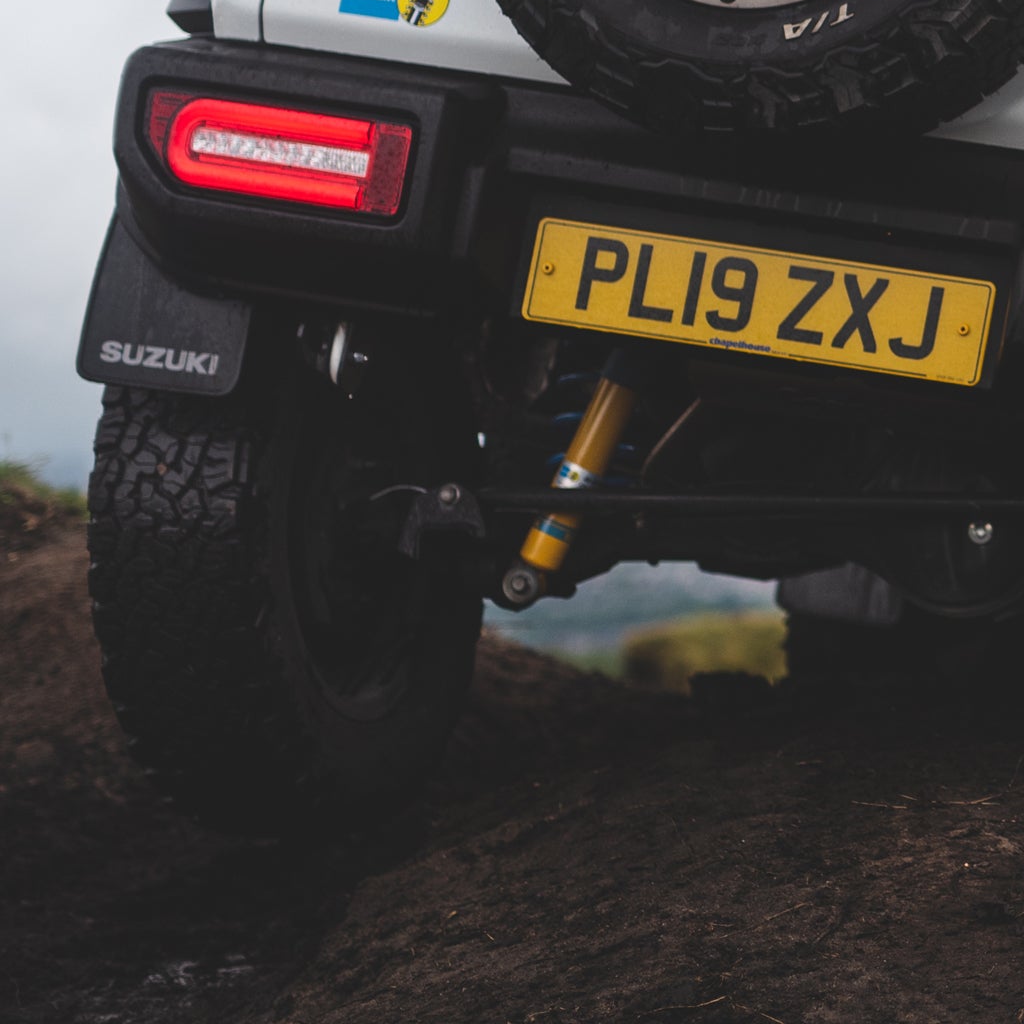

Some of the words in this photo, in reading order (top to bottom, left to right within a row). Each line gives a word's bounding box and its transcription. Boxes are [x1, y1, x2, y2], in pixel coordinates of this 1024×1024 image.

[782, 3, 854, 40] T/A
[575, 236, 759, 333] PL19
[776, 265, 945, 360] ZXJ
[100, 340, 219, 375] SUZUKI
